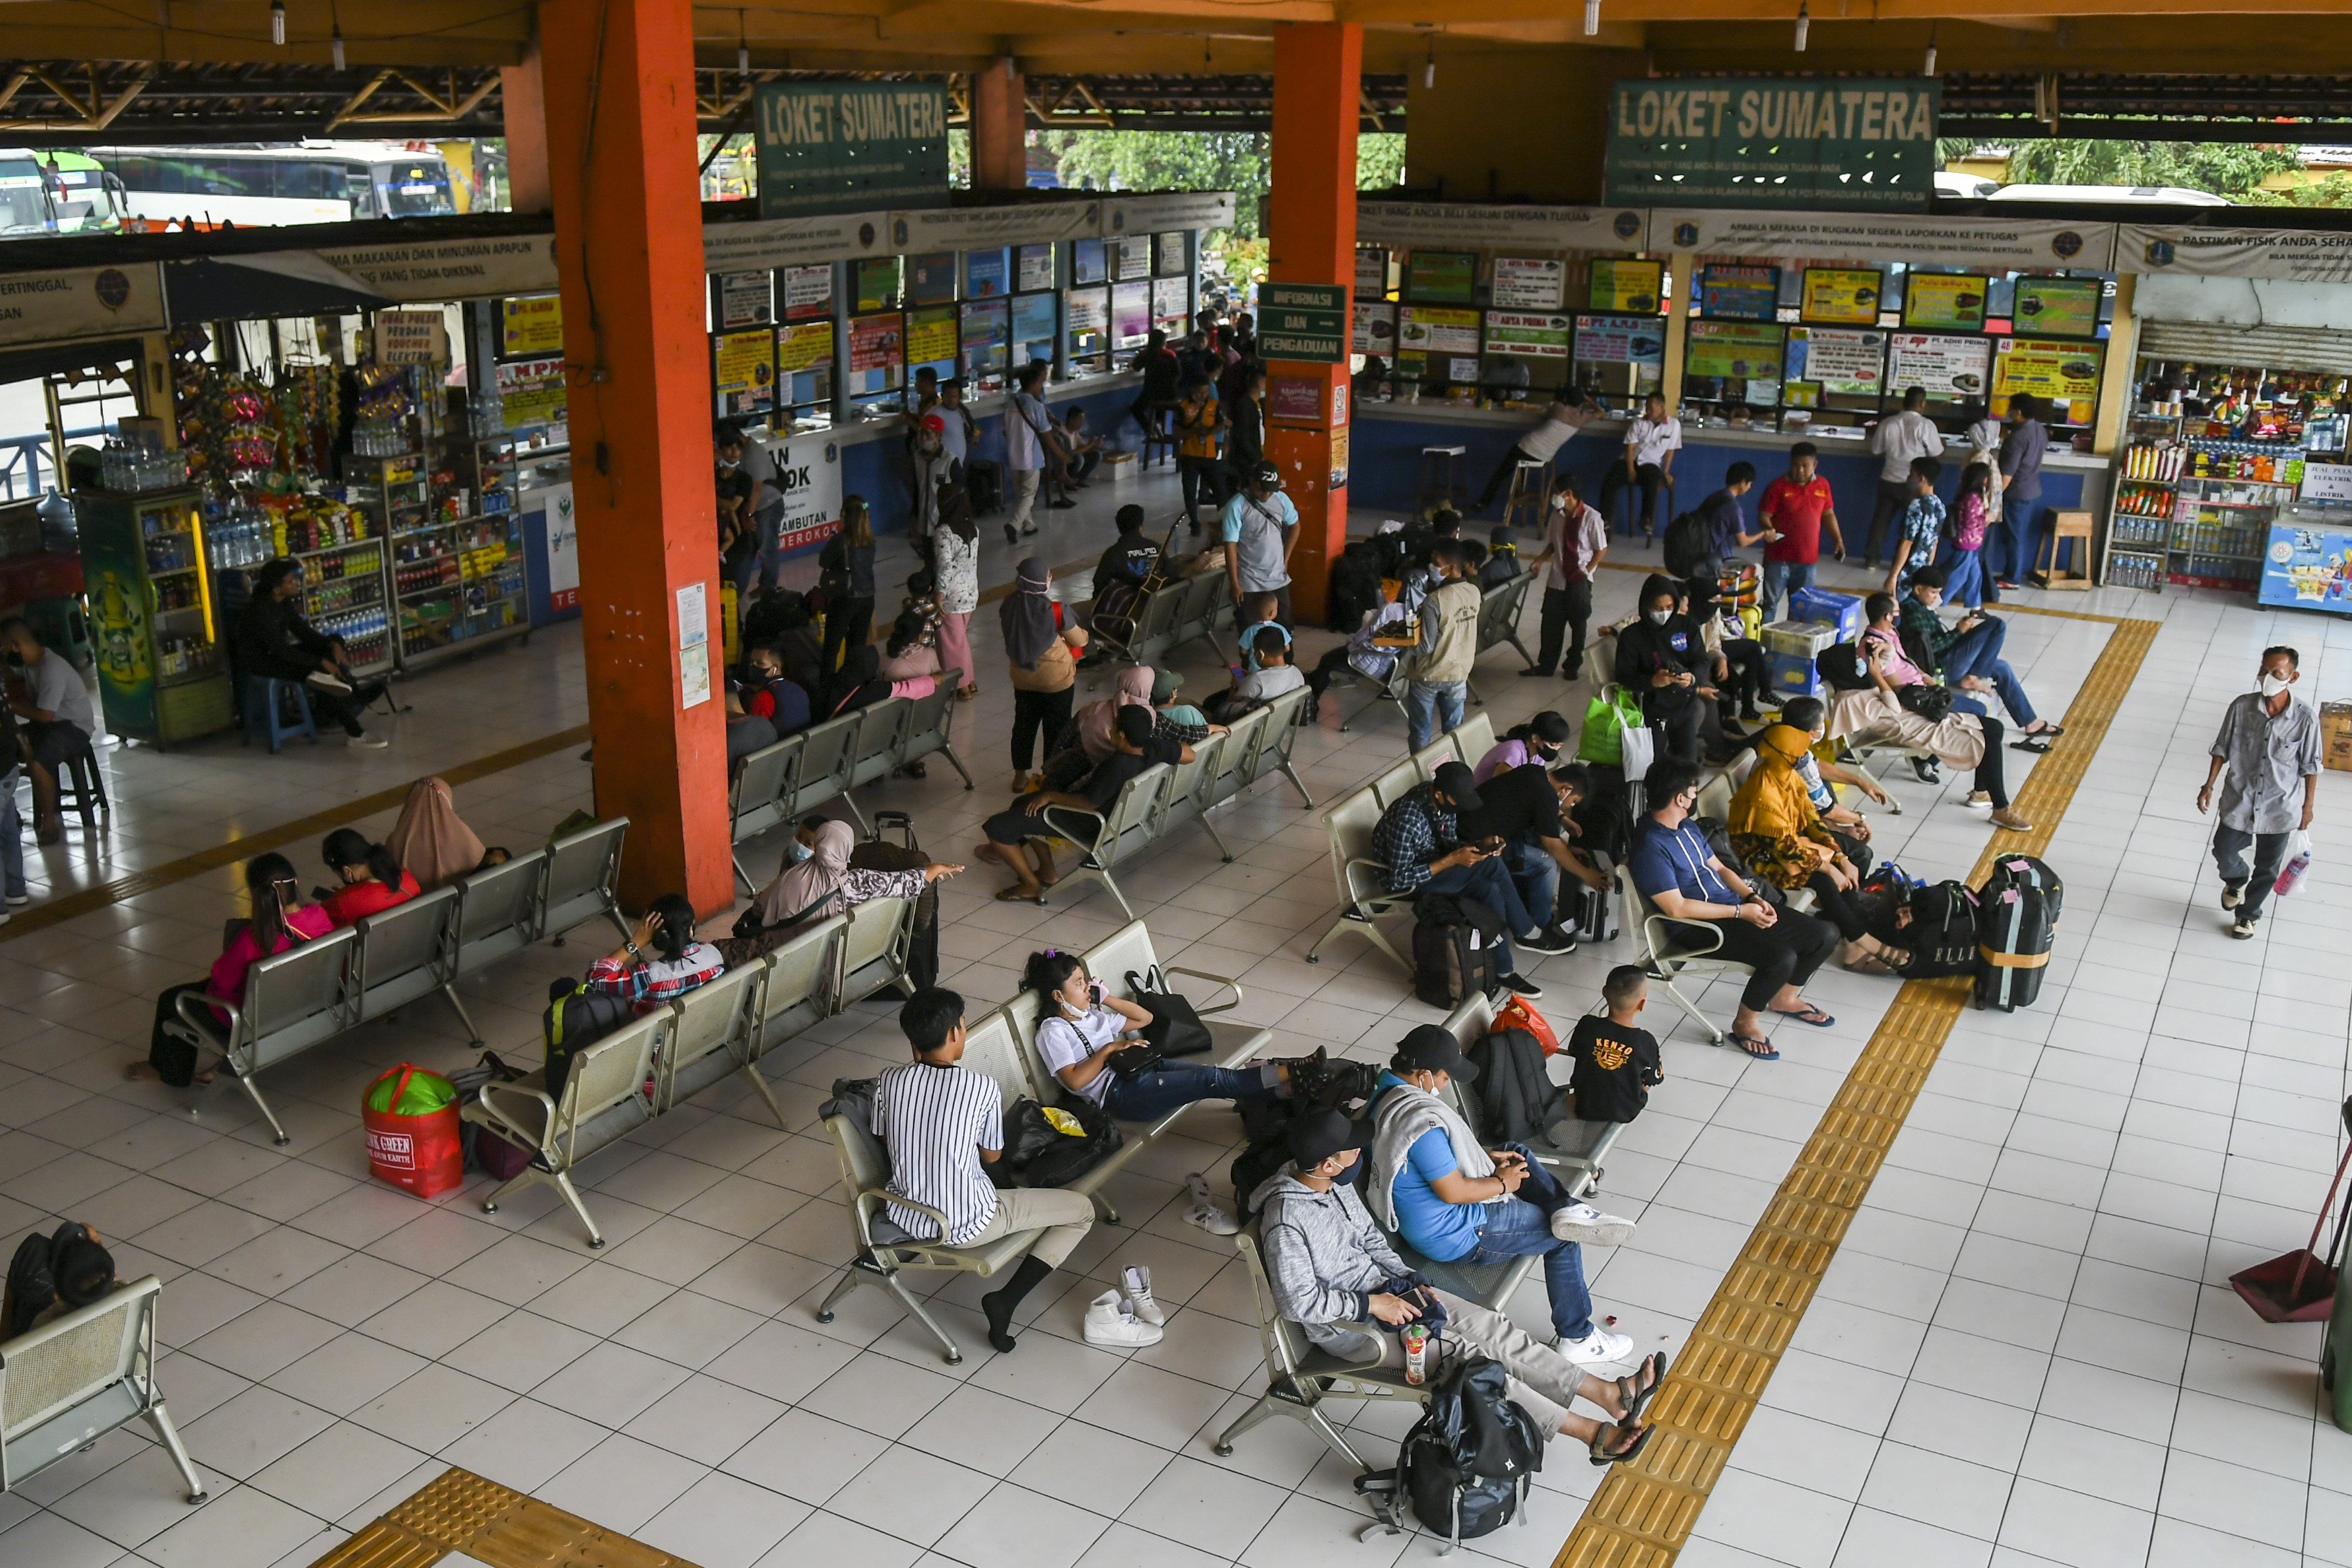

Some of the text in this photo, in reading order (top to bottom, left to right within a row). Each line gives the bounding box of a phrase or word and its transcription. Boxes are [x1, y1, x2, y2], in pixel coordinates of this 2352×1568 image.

[763, 92, 945, 146] LOKET SUMATERA
[1618, 89, 1932, 141] LOKET SUMATERA
[1816, 189, 1861, 199] PENGADUAN
[1863, 190, 1882, 200] ATAU
[1884, 191, 1900, 201] POS
[1901, 192, 1926, 202] POLISI
[1385, 206, 1410, 216] YANG
[1414, 208, 1441, 218] ANDA
[1444, 208, 1464, 218] BELI
[1469, 209, 1501, 219] SESUAI
[1504, 209, 1546, 220] DENGAN
[1549, 211, 1591, 222] TUJUAN
[1730, 222, 2019, 241] APABILA MERASA DI RUGIKAN SEGERA LAPORKAN KE PETUGAS
[1796, 237, 1828, 247] PETUGAS
[1876, 240, 1911, 250] ATAUPUN
[1913, 242, 1936, 251] POLISI
[1938, 243, 1959, 252] YANG
[1960, 245, 1991, 253] SEDANG
[1993, 246, 2033, 255] BERTUGAS
[2182, 235, 2243, 246] PASTIKAN
[2246, 235, 2277, 247] FISIK
[2279, 236, 2318, 247] ANDA
[353, 250, 409, 266] MAKANAN
[412, 247, 436, 262] DAN
[437, 244, 491, 260] MINUMAN
[493, 241, 532, 255] APAPUN
[380, 268, 408, 282] YANG
[410, 266, 442, 280] TIDAK
[443, 264, 486, 279] DIKENAL
[0, 278, 72, 295] ERTINGGAL,
[1274, 291, 1333, 307] INFORMASI
[1284, 315, 1307, 330] DAN
[1713, 309, 1760, 319] MUARA DUA
[387, 338, 430, 349] VOUCHER
[1263, 337, 1338, 354] PENGADUAN
[1893, 337, 1905, 345] 47
[2000, 341, 2012, 351] 48
[779, 510, 827, 534] AMBUTAN
[1595, 1038, 1634, 1055] KENZO
[380, 1135, 410, 1154] GREEN
[374, 1151, 387, 1161] OUR
[387, 1153, 411, 1165] EARTH
